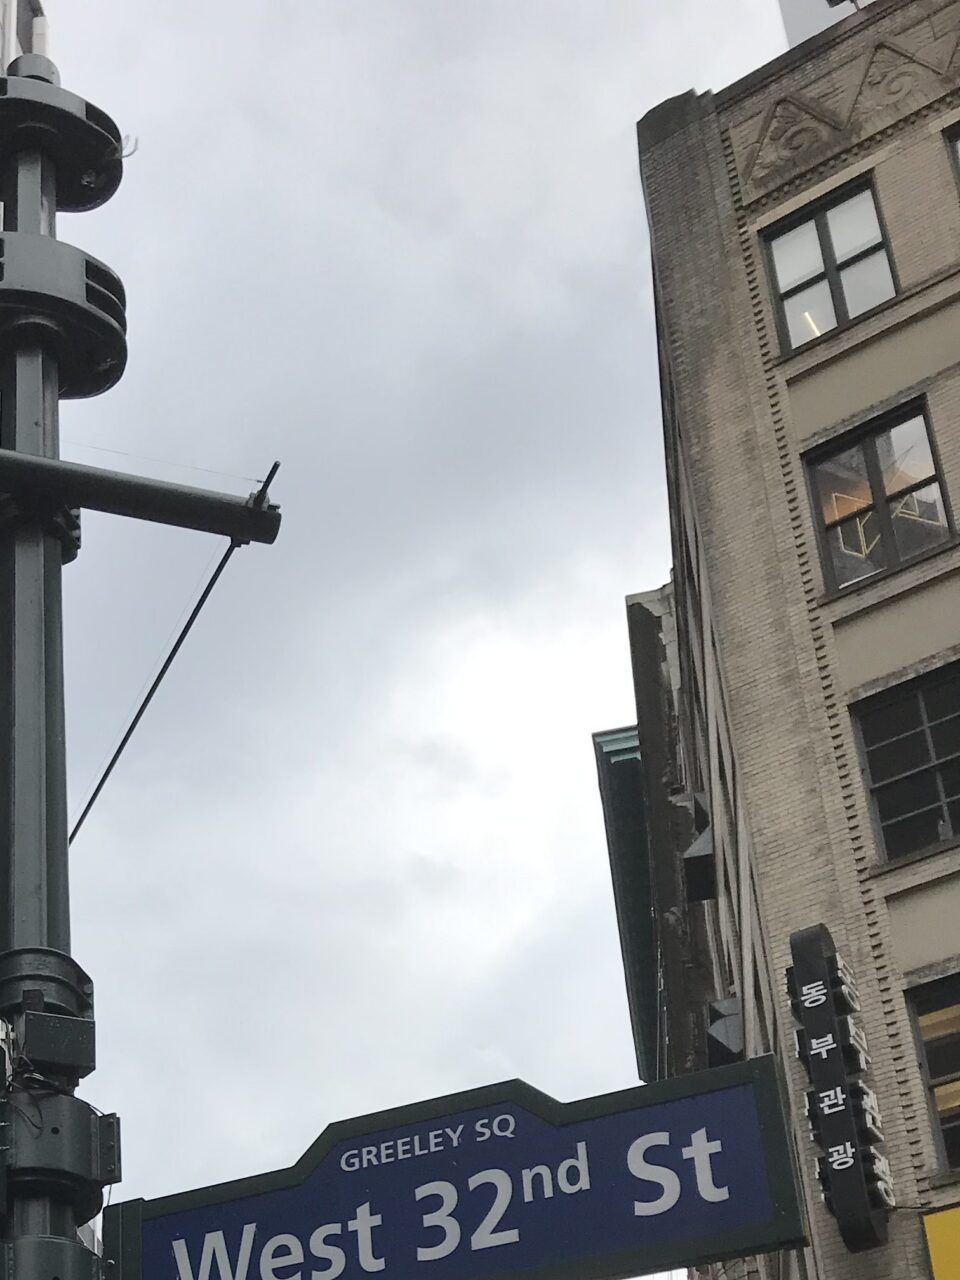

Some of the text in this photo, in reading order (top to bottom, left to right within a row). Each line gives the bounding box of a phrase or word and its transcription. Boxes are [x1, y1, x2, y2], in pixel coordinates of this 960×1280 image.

[340, 1113, 516, 1172] GREELEY SQ
[800, 981, 856, 1171] 동부관광
[415, 1142, 591, 1262] 32nd
[626, 1127, 730, 1217] St
